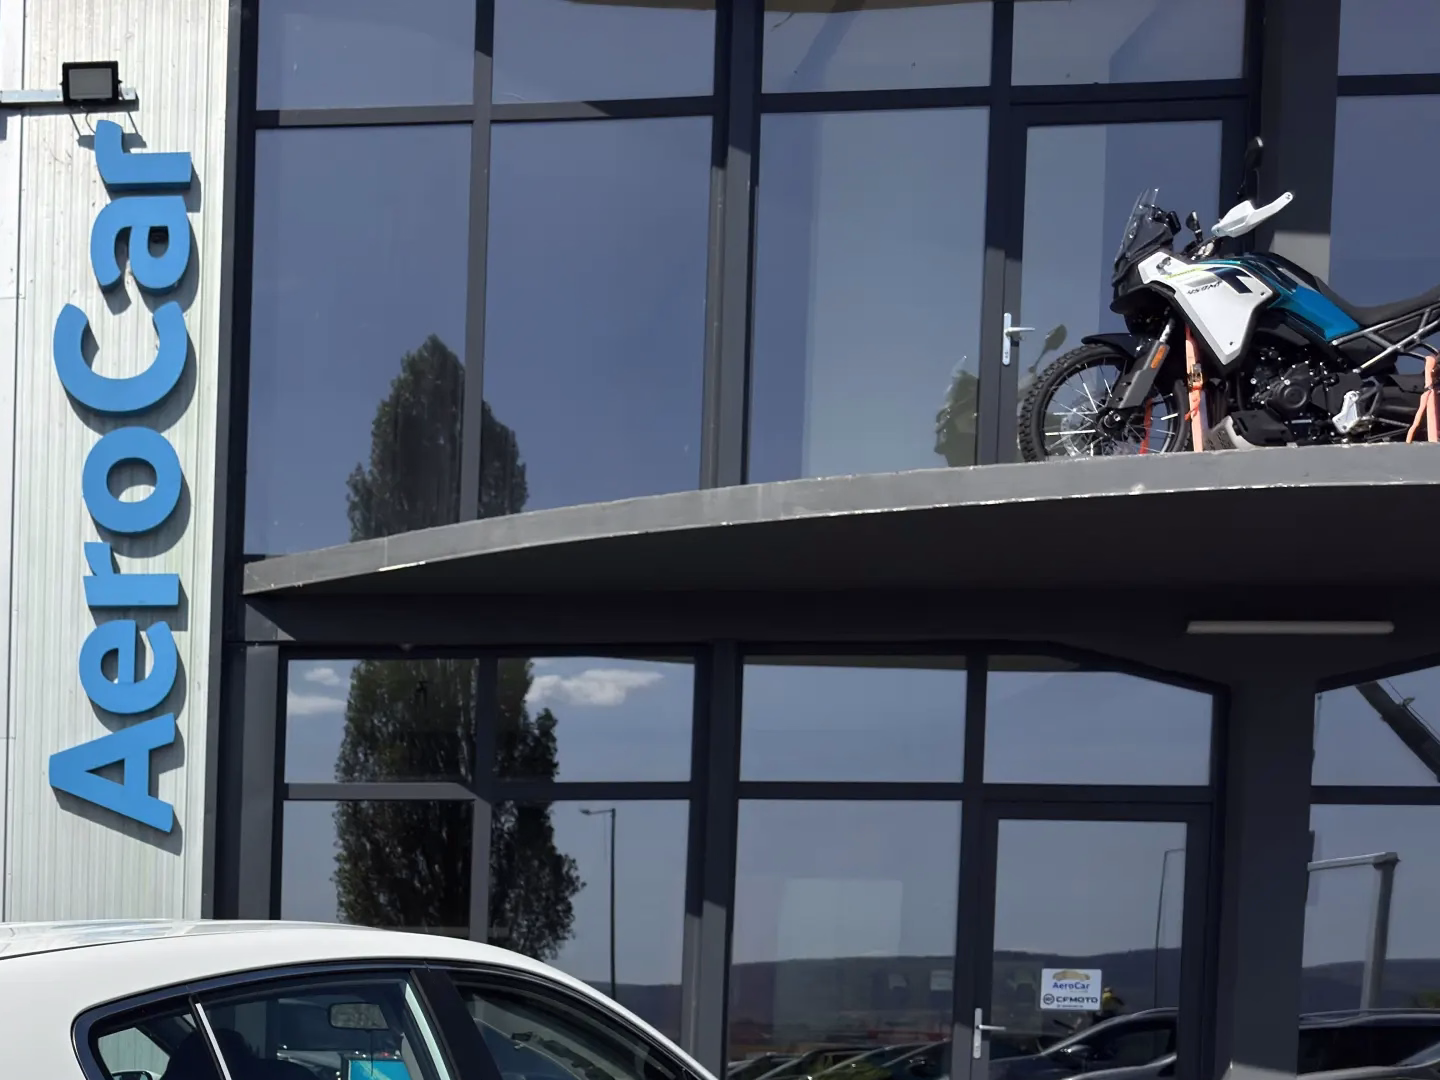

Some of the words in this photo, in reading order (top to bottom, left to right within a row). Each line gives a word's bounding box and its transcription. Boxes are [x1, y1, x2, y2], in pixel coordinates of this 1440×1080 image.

[48, 119, 192, 833] AeroCar
[1052, 981, 1091, 990] AeroCar
[1056, 996, 1099, 1004] CFMOTO
